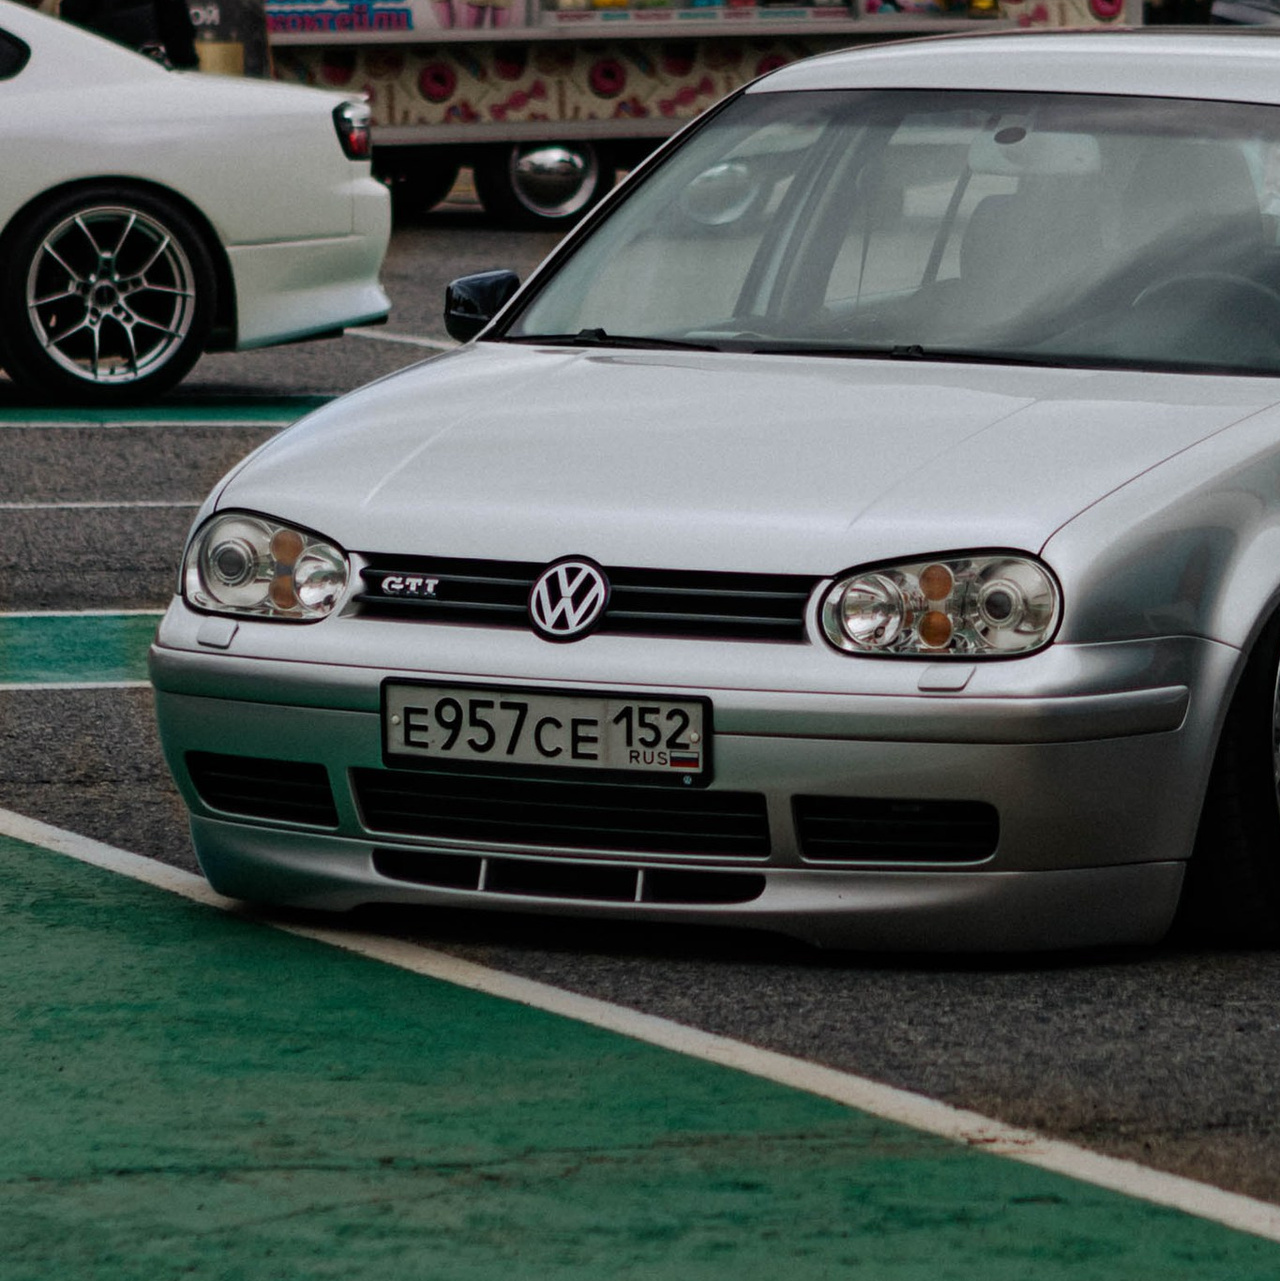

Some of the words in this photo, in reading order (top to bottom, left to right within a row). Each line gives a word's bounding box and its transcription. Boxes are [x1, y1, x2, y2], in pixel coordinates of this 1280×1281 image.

[381, 575, 439, 597] GTI
[612, 705, 690, 750] 152
[629, 750, 668, 766] RUS
